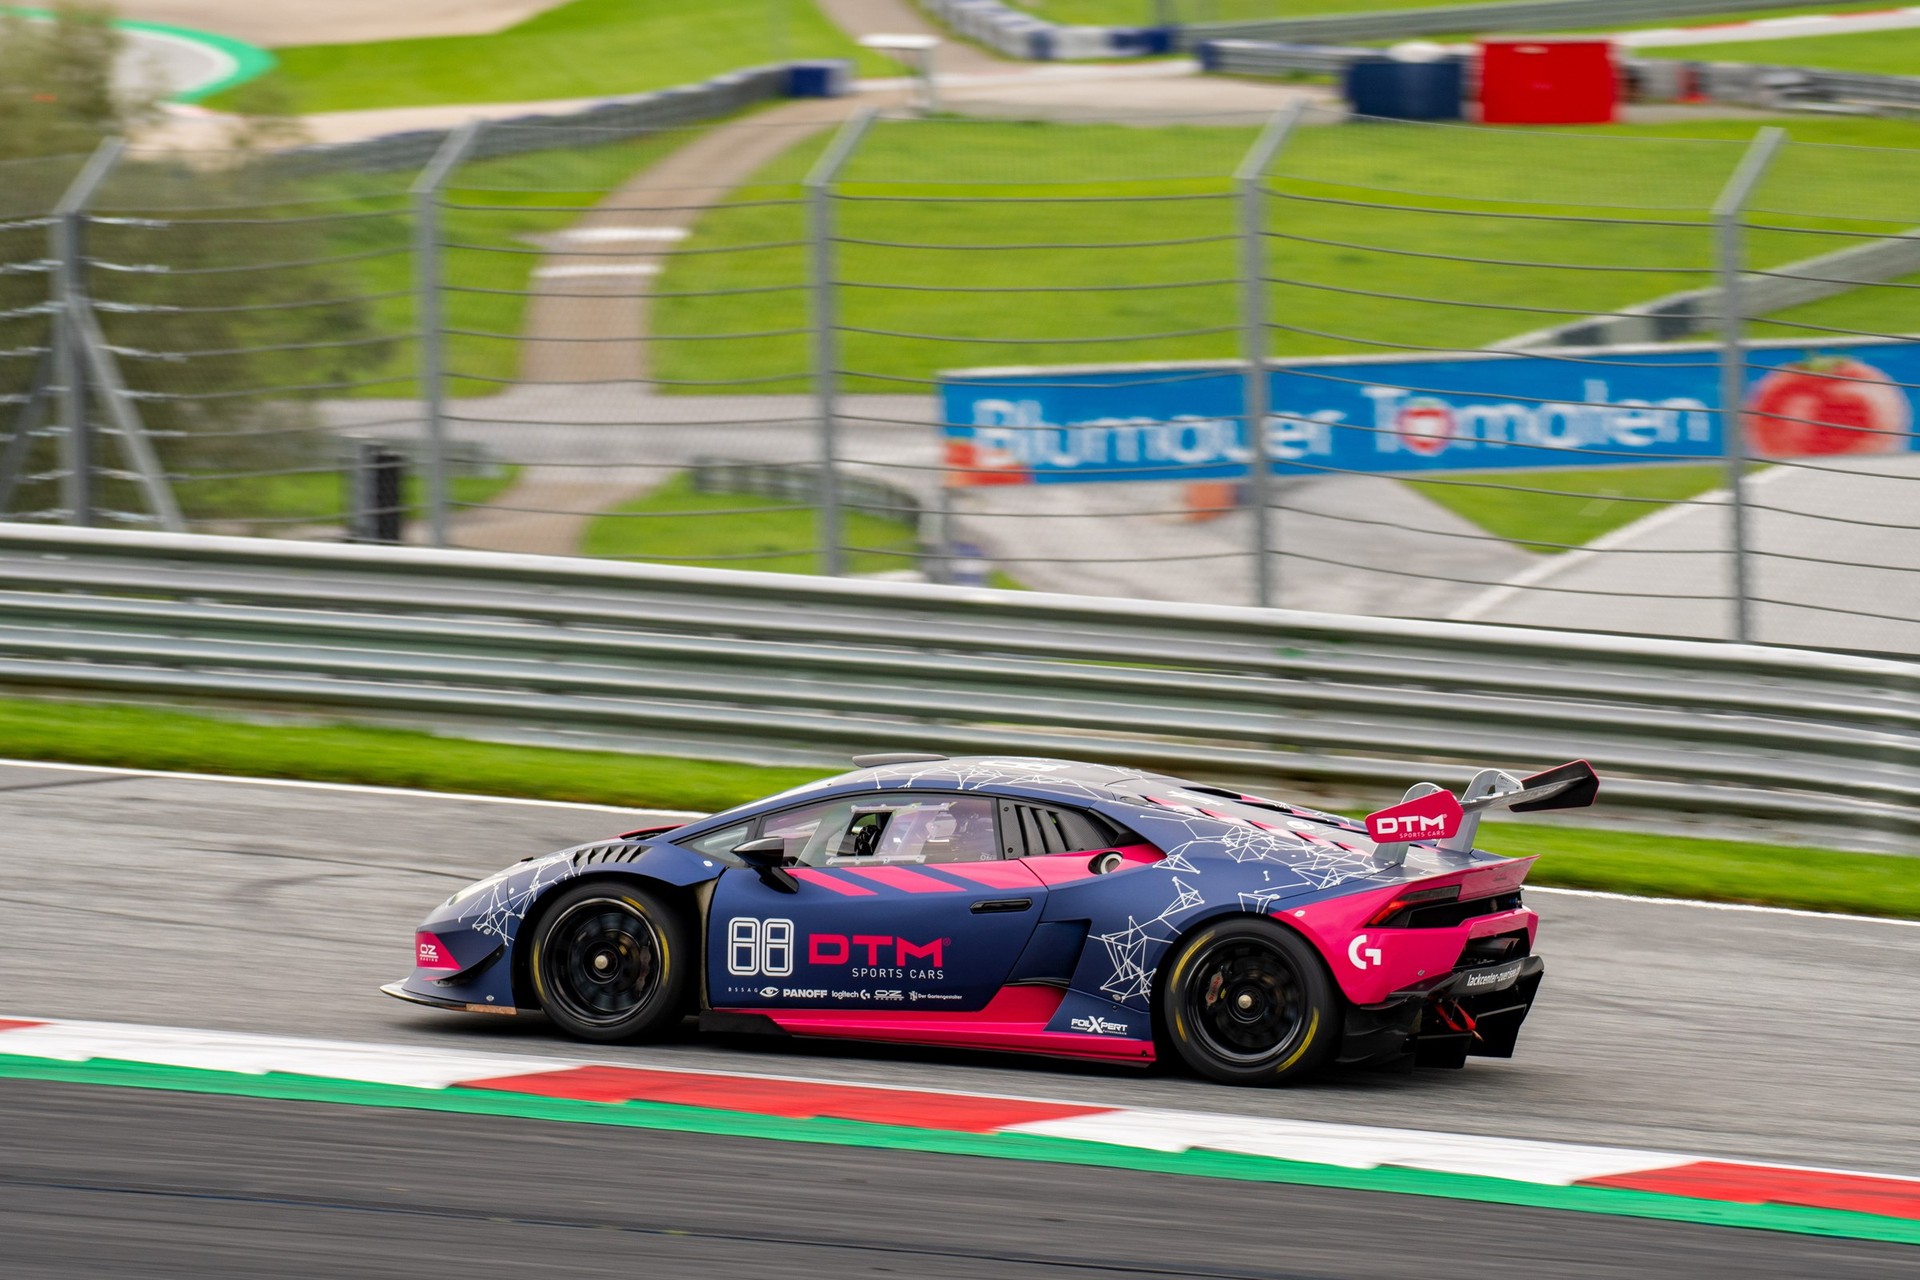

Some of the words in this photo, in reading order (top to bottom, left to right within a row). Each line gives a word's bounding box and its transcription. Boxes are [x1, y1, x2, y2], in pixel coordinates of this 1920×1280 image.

[728, 917, 794, 976] 88
[852, 967, 903, 978] SPORTS
[909, 969, 944, 979] CARS
[783, 989, 828, 998] PANOFF
[831, 990, 859, 999] logitech
